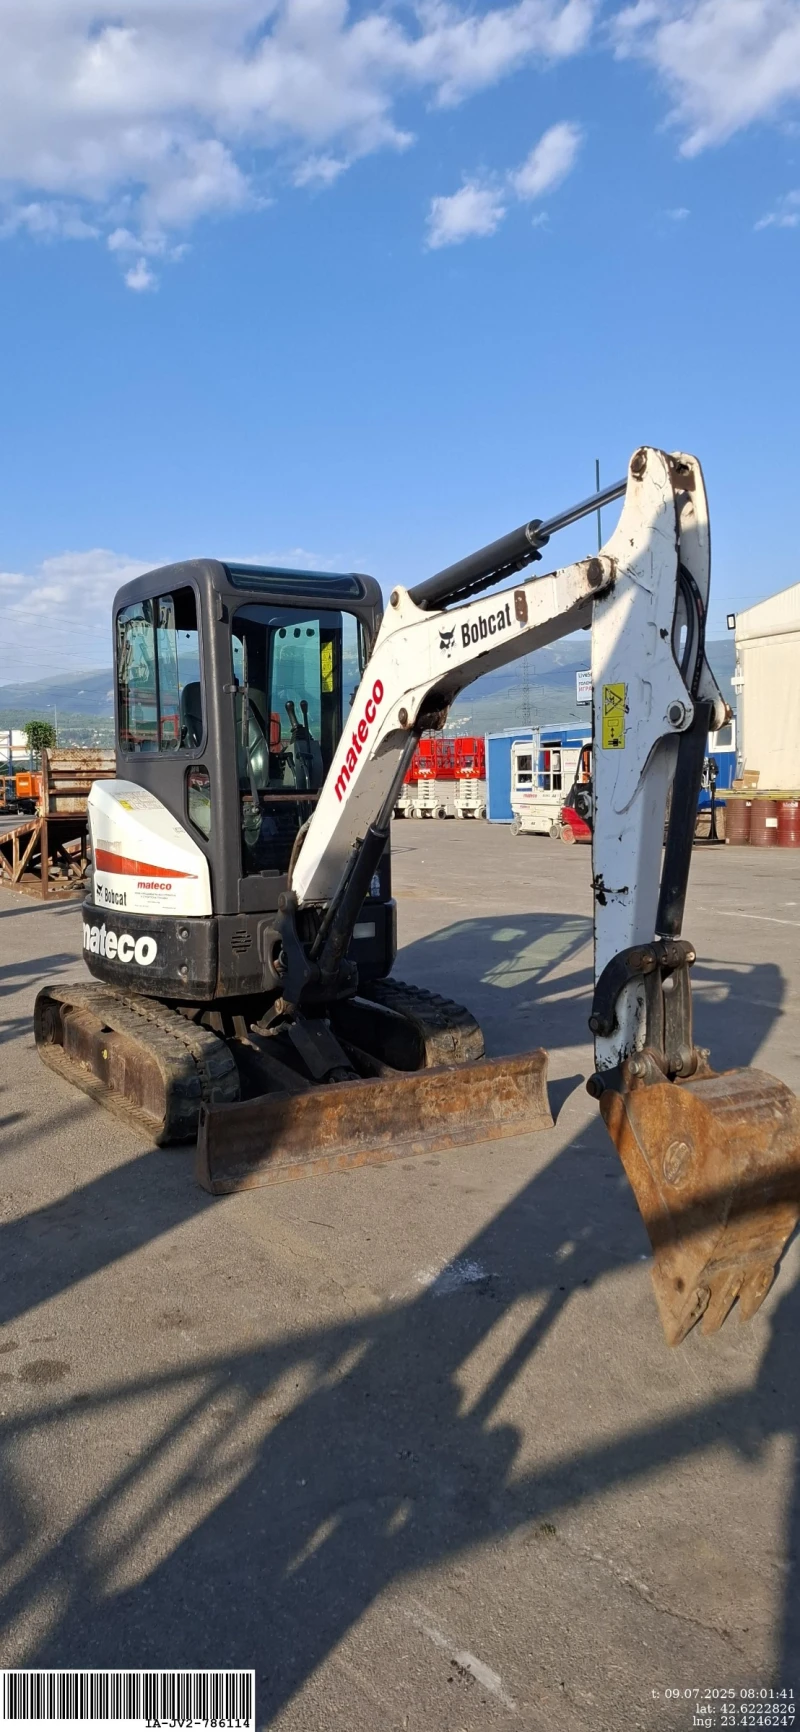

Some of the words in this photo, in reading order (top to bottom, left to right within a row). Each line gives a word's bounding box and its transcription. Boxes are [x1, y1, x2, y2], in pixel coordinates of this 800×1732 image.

[461, 603, 511, 648] Bobcat
[334, 679, 384, 803] mateco
[104, 888, 127, 906] Bobcat
[137, 881, 172, 891] mateco
